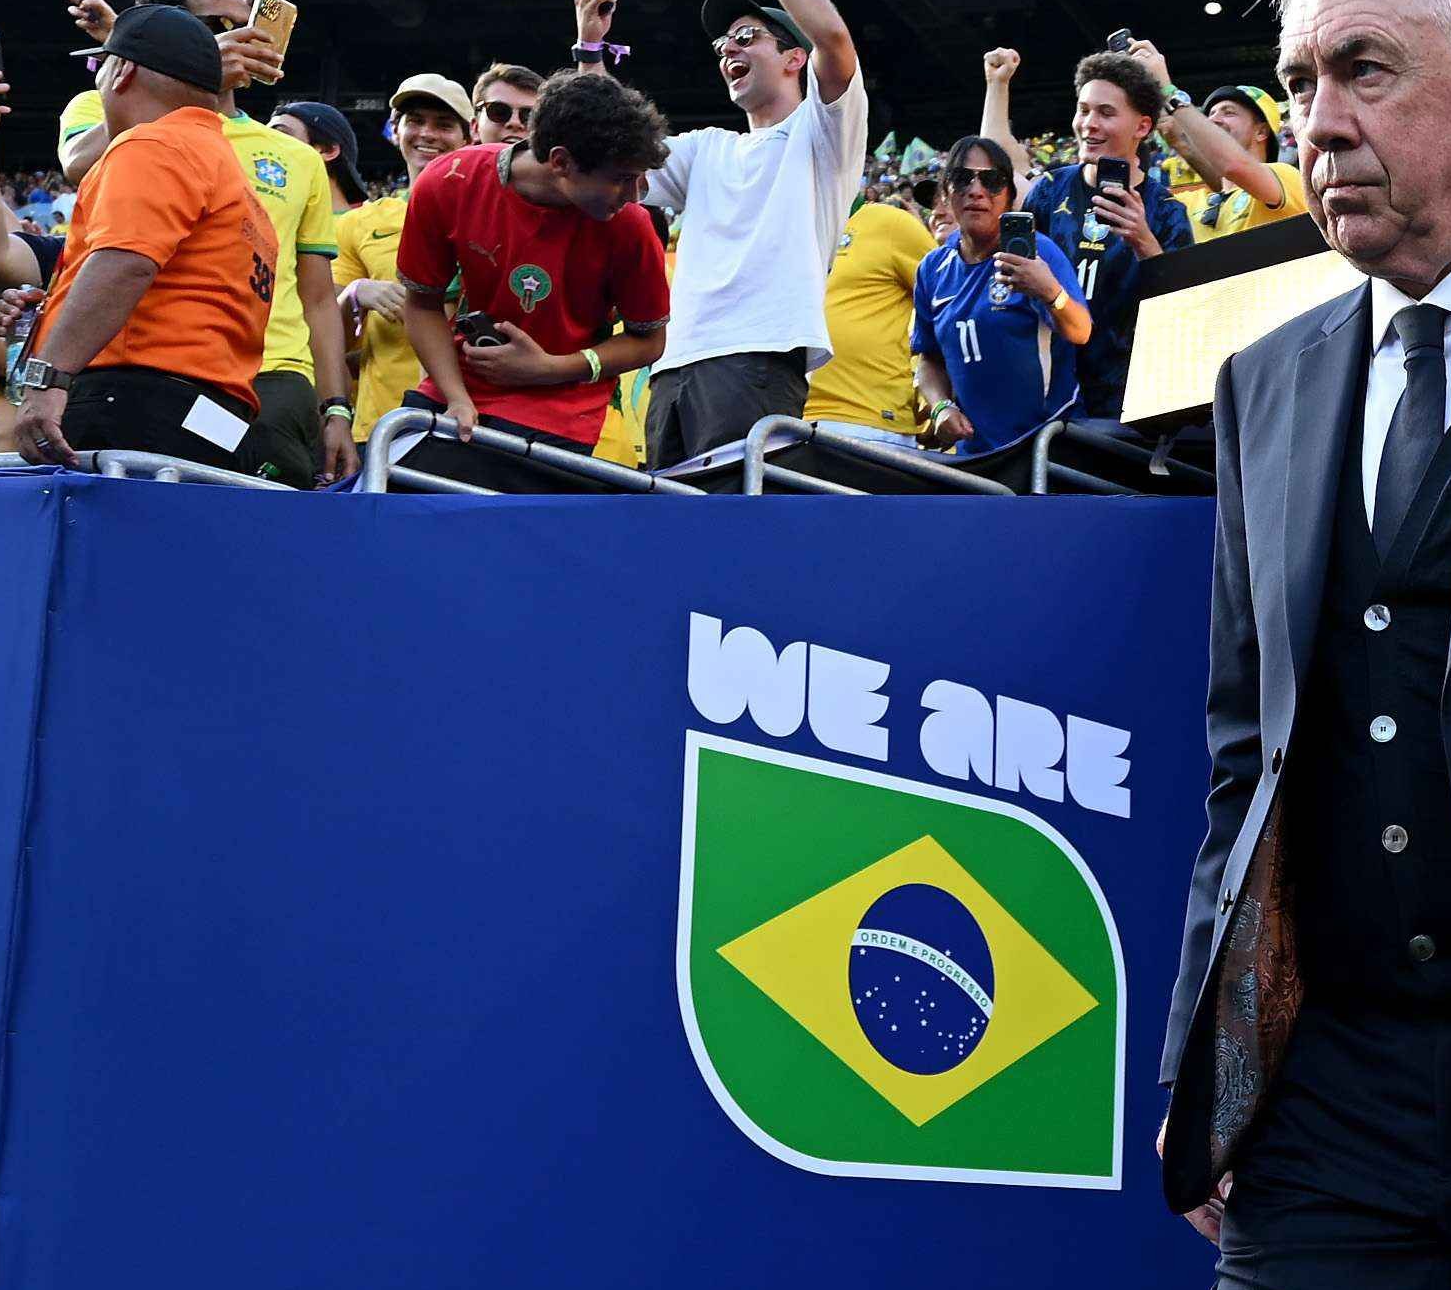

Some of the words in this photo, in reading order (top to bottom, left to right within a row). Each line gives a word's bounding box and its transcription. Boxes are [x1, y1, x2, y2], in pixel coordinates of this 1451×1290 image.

[956, 318, 982, 363] 11
[687, 611, 890, 762] WE
[861, 932, 907, 949] ORDEM
[921, 949, 989, 1008] PROGRESSO
